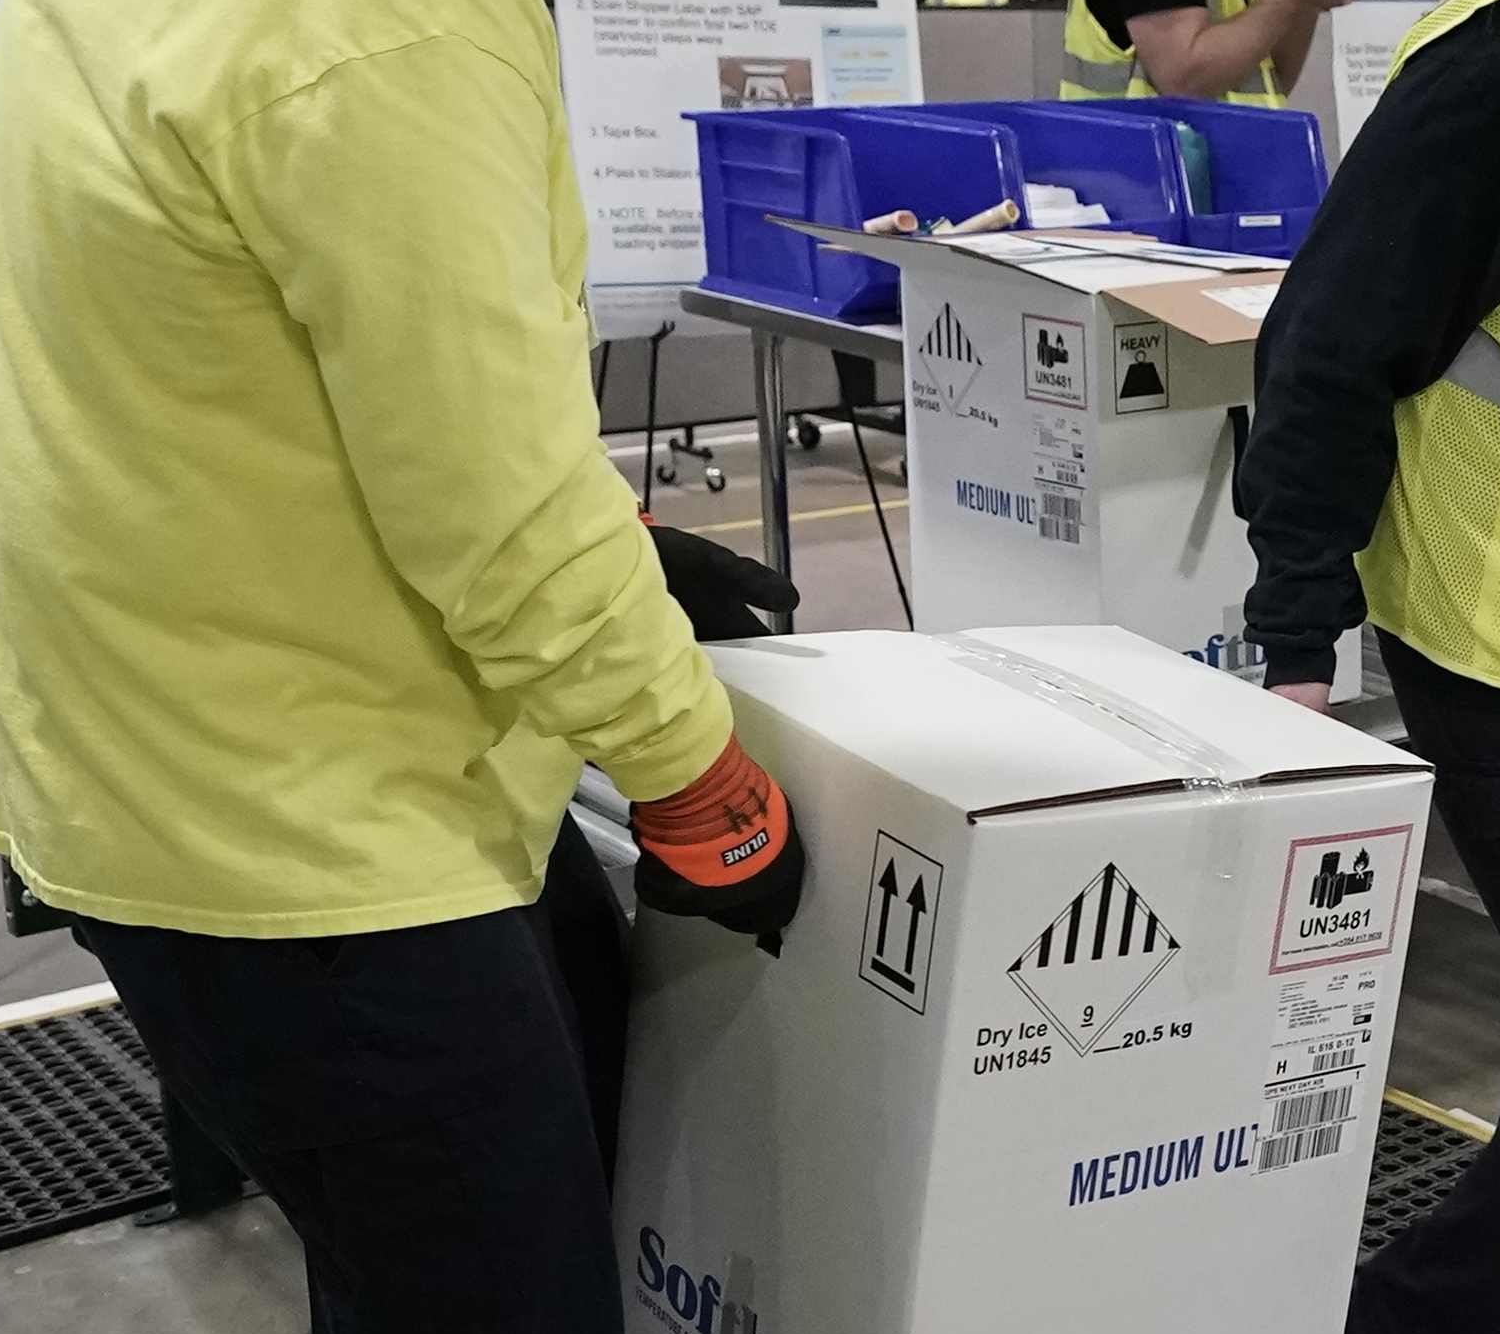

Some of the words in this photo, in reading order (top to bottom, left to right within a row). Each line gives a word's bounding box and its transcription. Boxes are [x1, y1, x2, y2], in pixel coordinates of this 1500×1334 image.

[1120, 334, 1163, 351] HEAVY
[955, 479, 1011, 519] MEDIUM
[1015, 491, 1036, 525] UL
[723, 831, 768, 865] ULINE
[1299, 908, 1371, 938] UN3481
[1357, 979, 1376, 991] PRO
[1082, 1005, 1095, 1023] 9
[975, 1027, 1013, 1048] Dry
[1018, 1023, 1049, 1040] Ice
[1121, 1025, 1164, 1050] 20.5
[1169, 1021, 1193, 1040] kg
[972, 1046, 1053, 1076] UN1845
[1276, 1059, 1287, 1076] H
[1068, 1135, 1205, 1207] MEDIUM
[1213, 1123, 1259, 1174] UL
